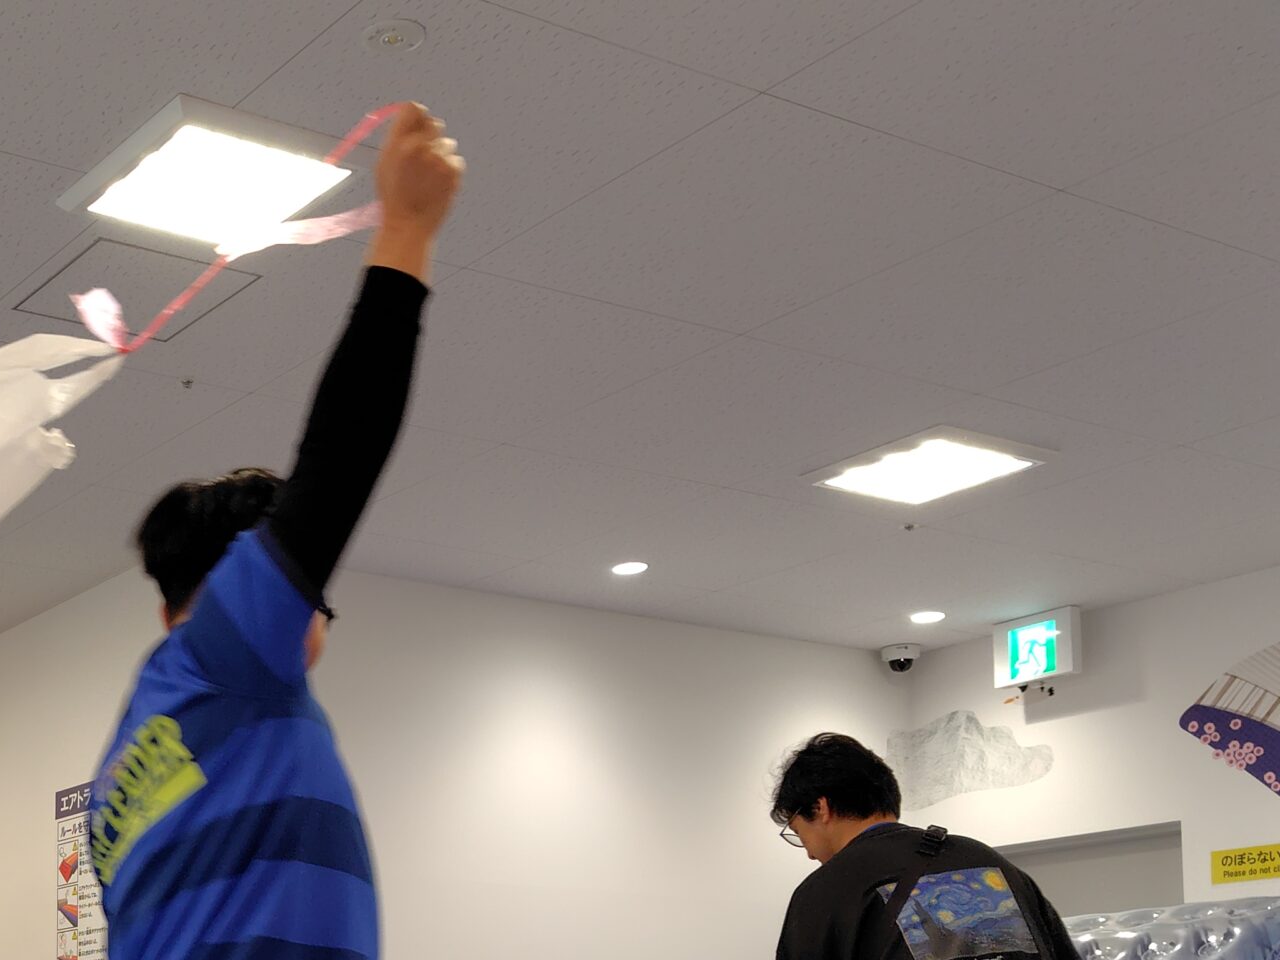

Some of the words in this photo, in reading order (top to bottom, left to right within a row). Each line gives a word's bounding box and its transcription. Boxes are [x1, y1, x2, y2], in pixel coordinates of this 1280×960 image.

[60, 788, 92, 812] エアトラ
[1223, 870, 1246, 878] Please
[1248, 867, 1258, 876] do
[1259, 866, 1272, 875] not
